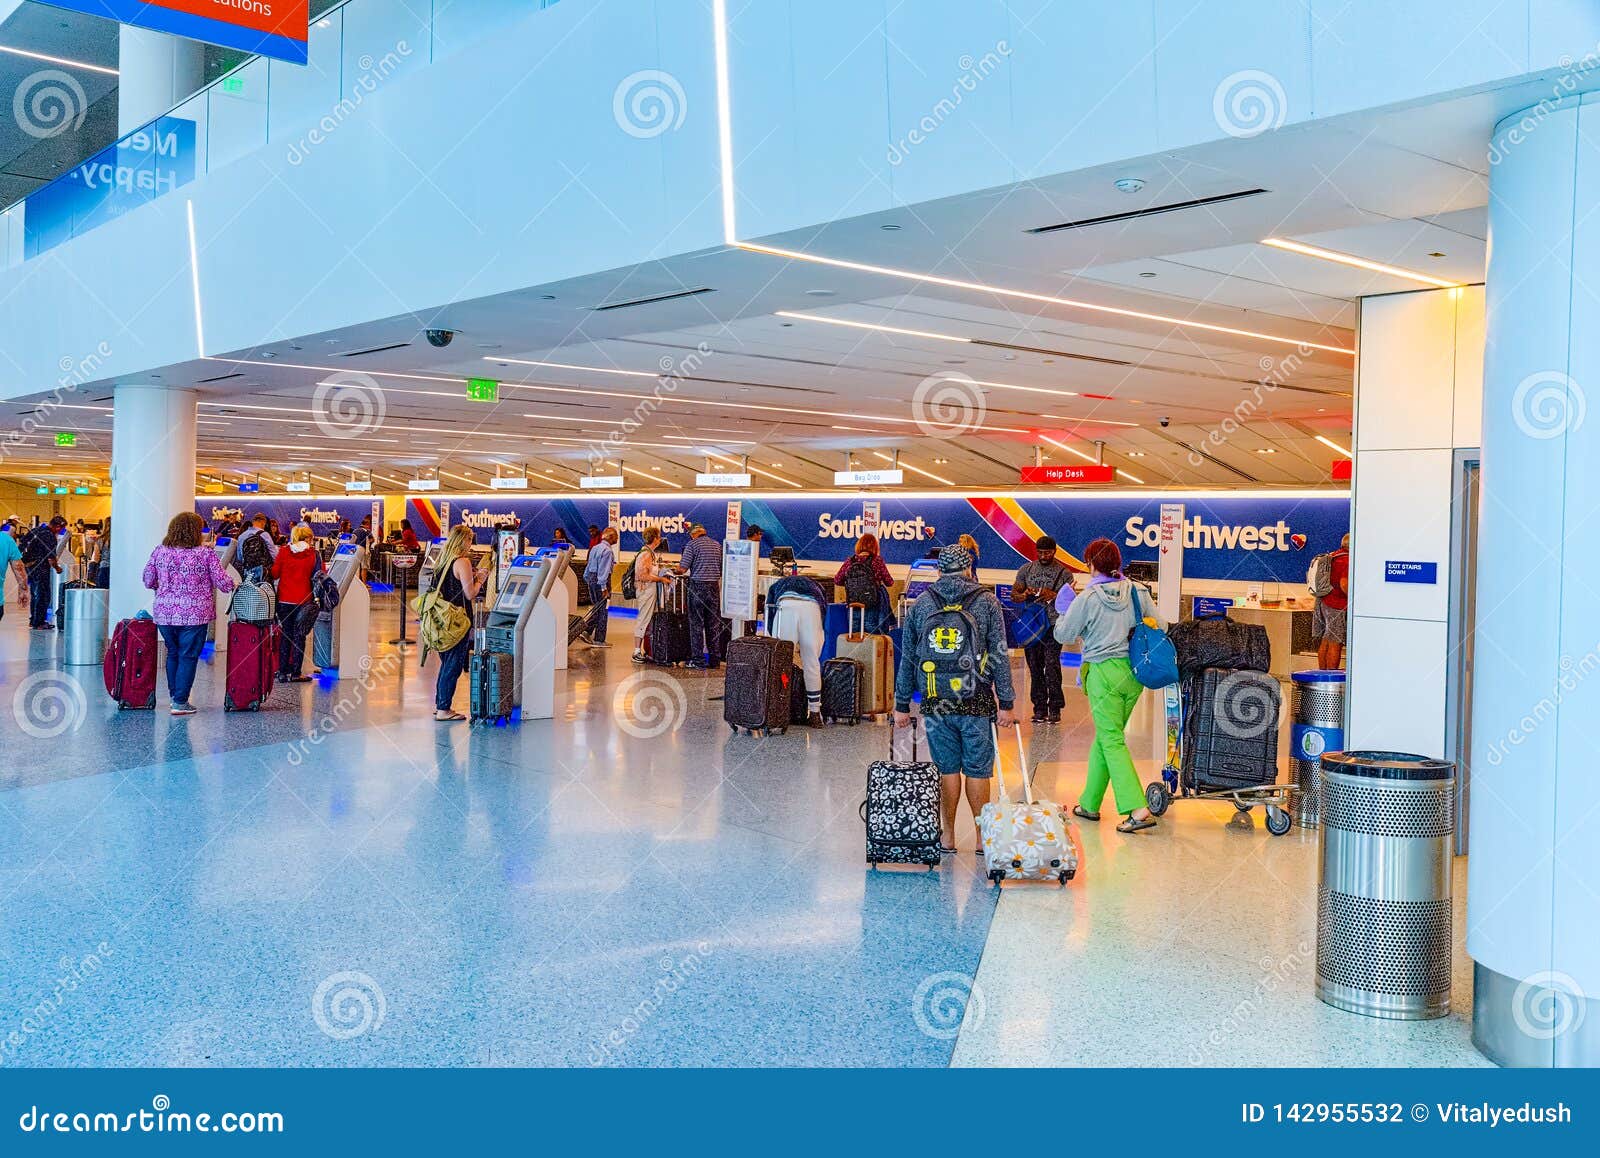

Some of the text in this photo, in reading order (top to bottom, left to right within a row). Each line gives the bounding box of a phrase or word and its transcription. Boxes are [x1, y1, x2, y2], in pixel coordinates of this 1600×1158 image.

[1046, 469, 1085, 479] Help Desk
[619, 510, 685, 533] outhwest
[864, 511, 874, 520] Bag
[818, 513, 925, 541] Soutwest
[864, 520, 878, 528] Drop
[1125, 516, 1290, 551] Sothwest
